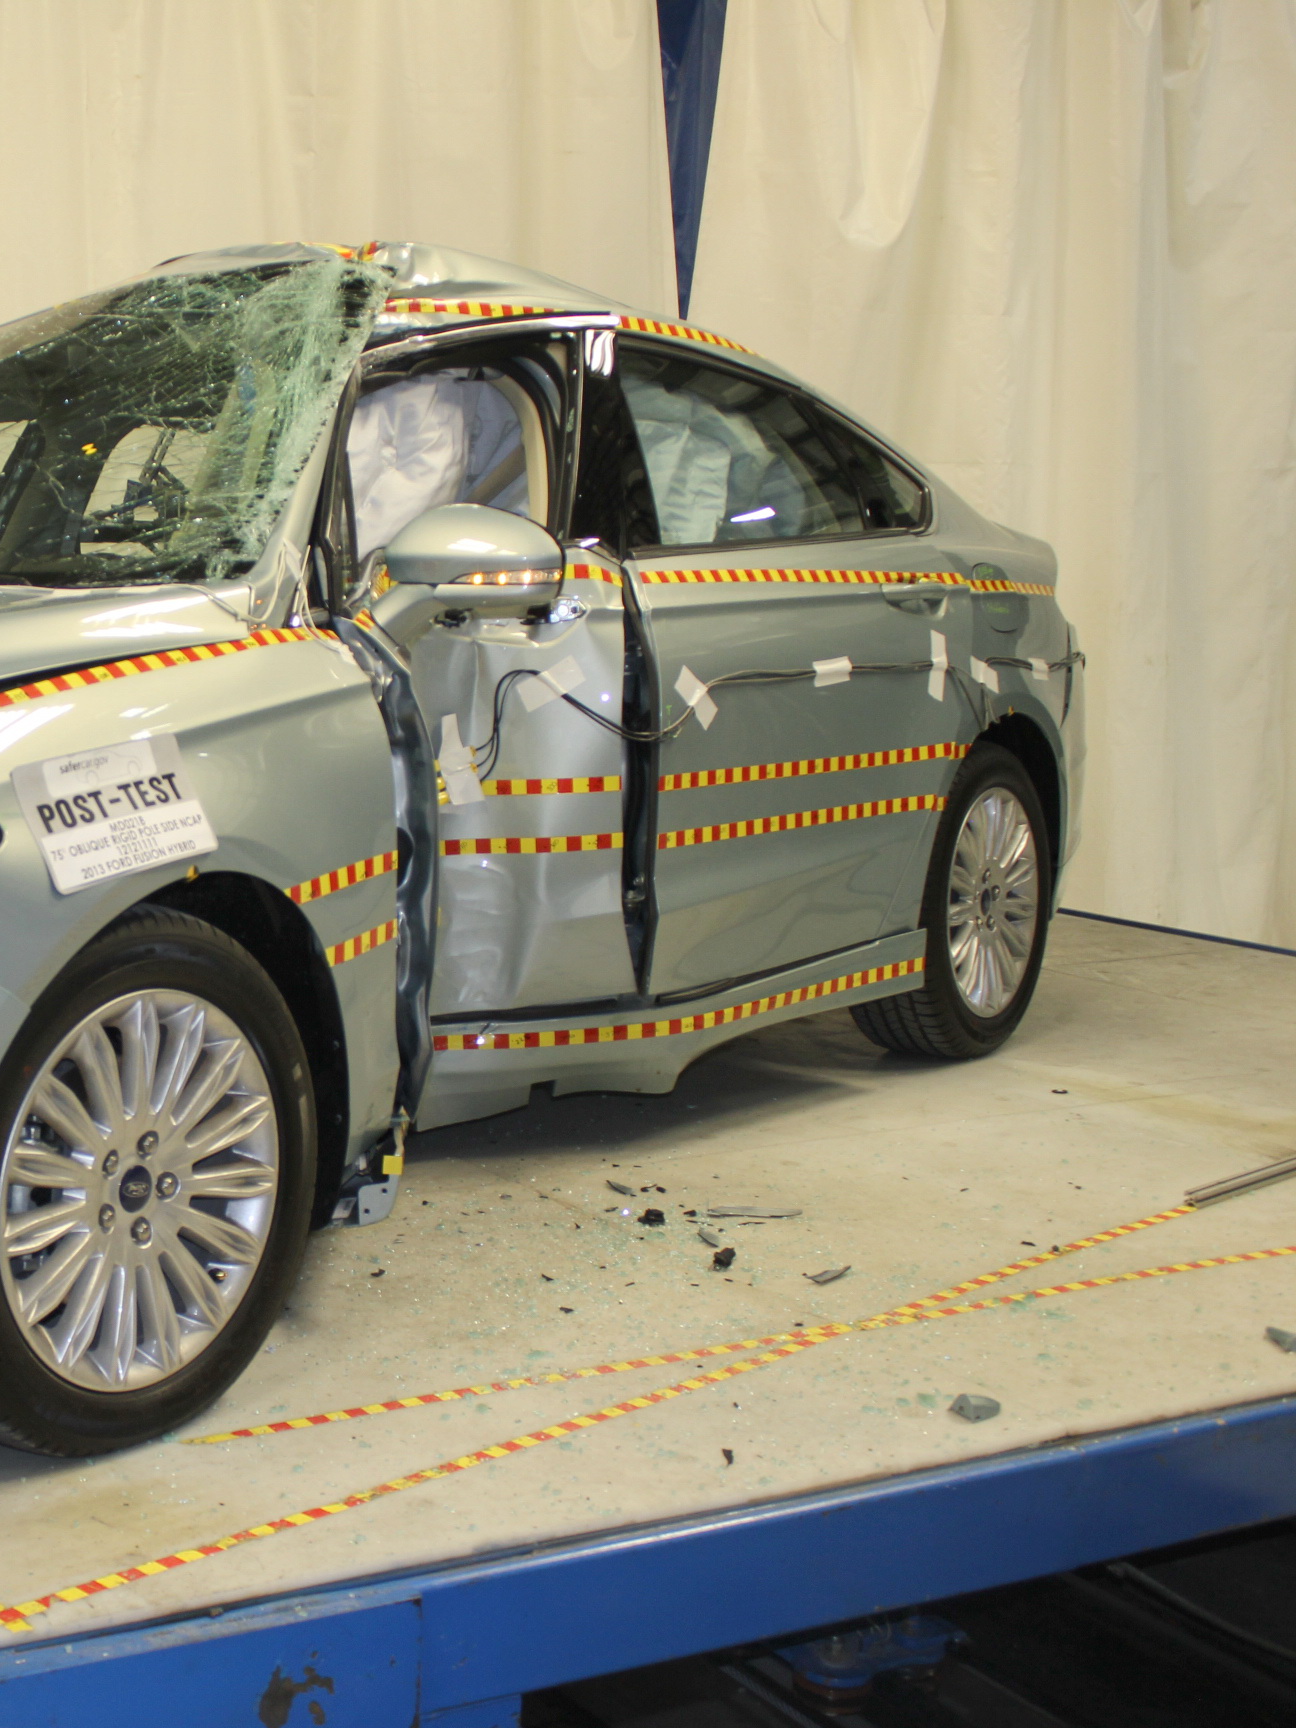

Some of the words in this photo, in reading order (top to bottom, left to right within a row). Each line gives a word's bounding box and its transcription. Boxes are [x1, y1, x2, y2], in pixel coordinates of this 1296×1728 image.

[59, 756, 109, 774] safercar.gov
[37, 773, 182, 834] POST-TEST
[109, 816, 146, 832] MD0218
[68, 836, 110, 857] OBLIQUE
[110, 830, 138, 845] RIGID
[138, 823, 161, 838] POLE
[160, 819, 180, 833] SIDE
[179, 814, 203, 828] NCAP
[81, 863, 106, 880] 2013
[105, 856, 133, 872] FORD
[133, 847, 167, 863] FUSION
[167, 839, 197, 854] HYBRID
